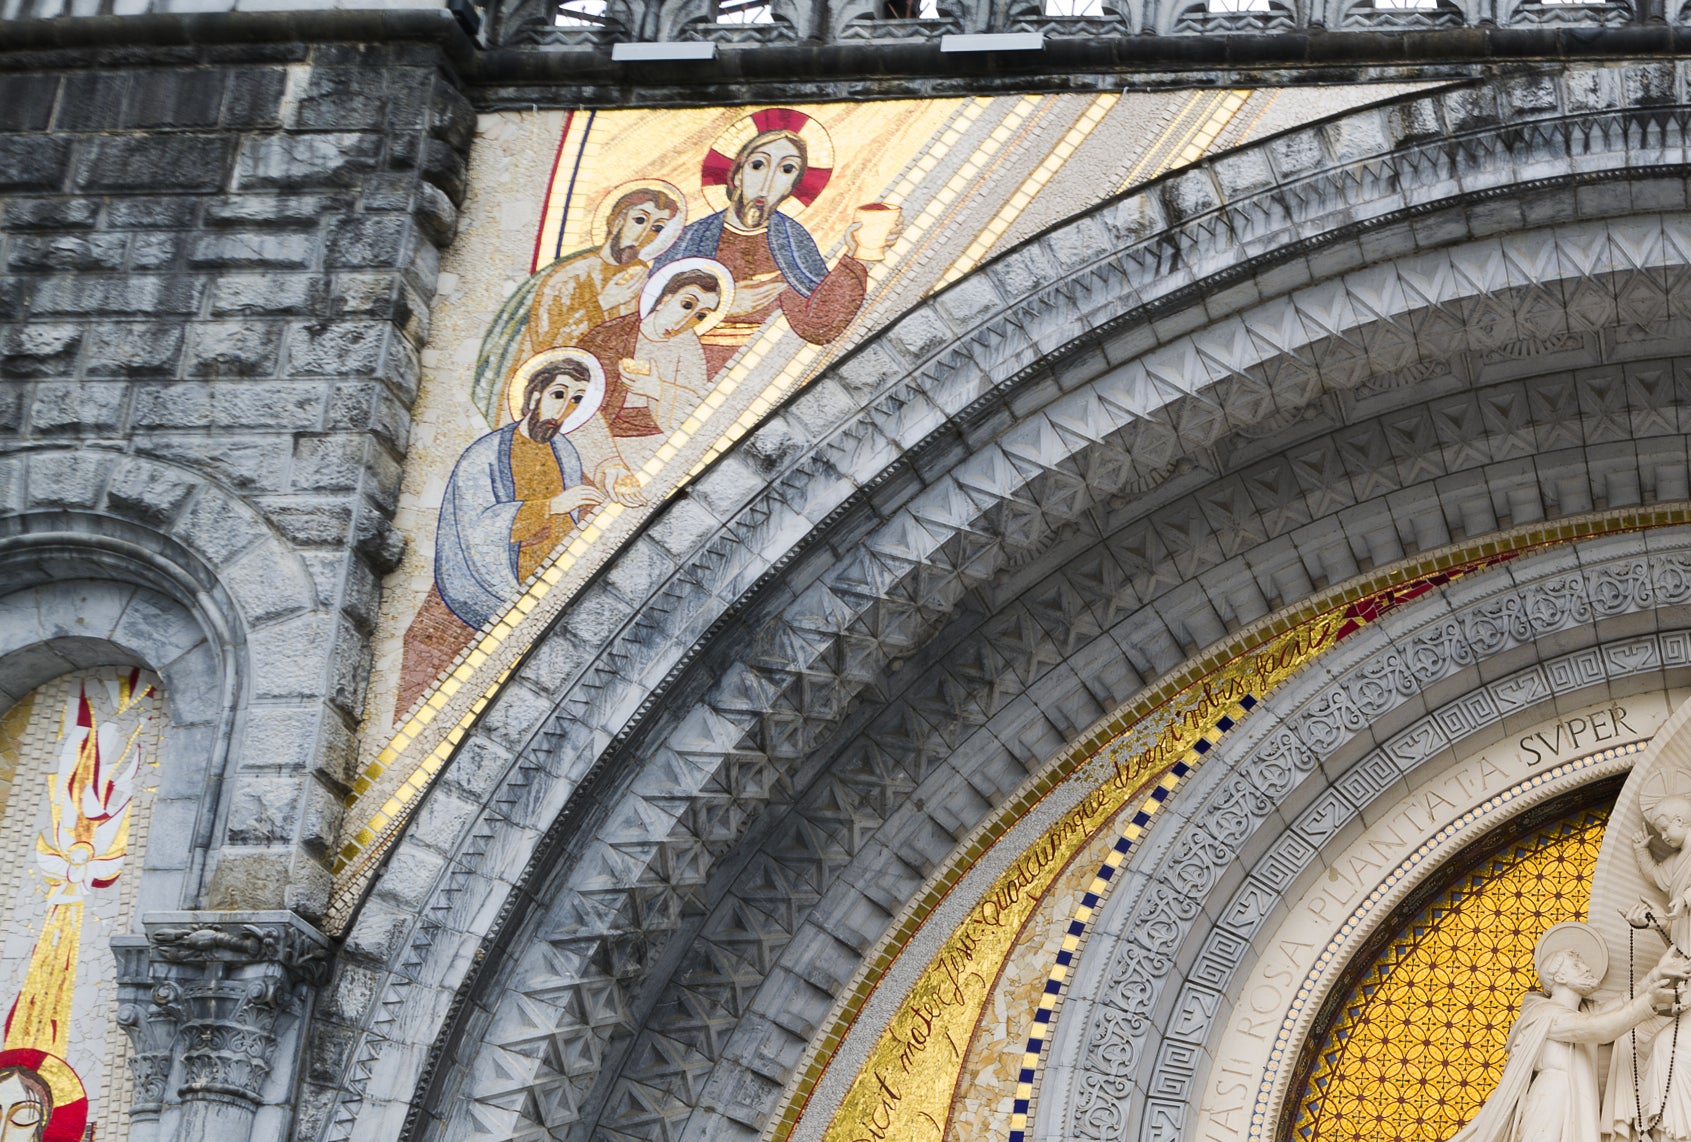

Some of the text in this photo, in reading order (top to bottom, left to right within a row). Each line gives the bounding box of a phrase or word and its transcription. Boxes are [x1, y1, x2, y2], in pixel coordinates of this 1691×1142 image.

[900, 987, 950, 1075] mater
[1256, 622, 1331, 691] facite
[1236, 940, 1314, 1042] ROSA
[1308, 756, 1510, 926] PLANTATA
[1520, 706, 1637, 767] SVPER
